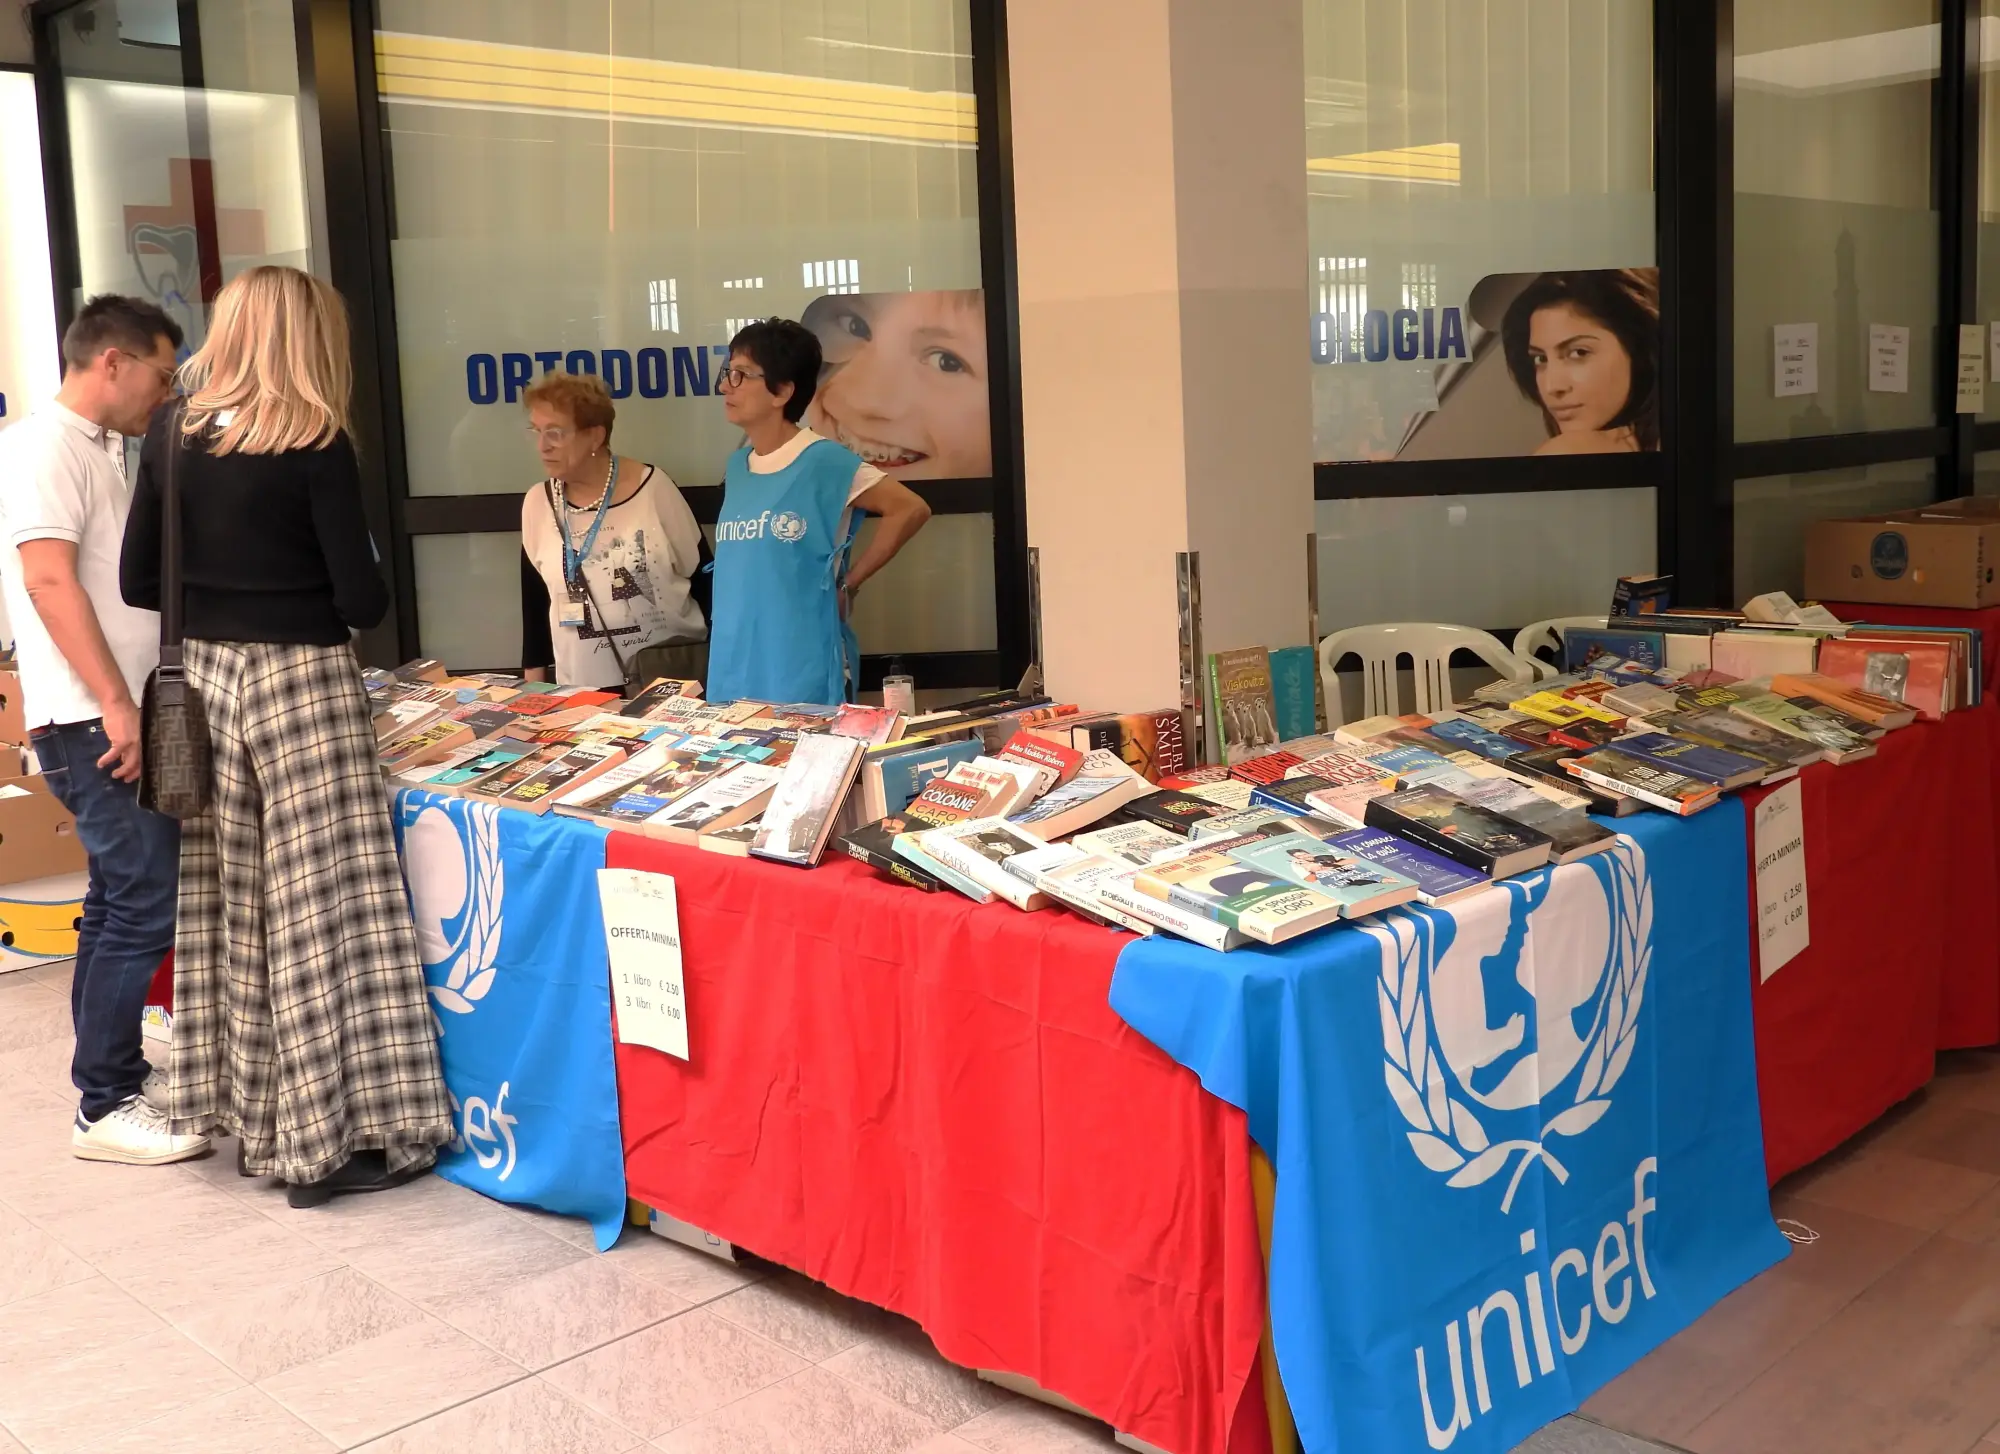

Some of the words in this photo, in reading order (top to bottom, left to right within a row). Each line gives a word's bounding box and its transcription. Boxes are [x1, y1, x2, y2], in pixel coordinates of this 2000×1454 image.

[715, 510, 770, 542] unicef
[621, 630, 652, 647] spirit
[655, 684, 681, 695] Tyler
[1224, 676, 1265, 691] Viskovitz
[1009, 743, 1024, 753] John
[1044, 755, 1065, 768] Roberts
[1296, 753, 1357, 776] GIORGIO
[921, 789, 978, 811] COLOANE
[932, 784, 977, 800] FRANCISCO
[915, 804, 958, 822] CAPO
[848, 843, 870, 857] TRUMAN
[848, 850, 869, 864] CAPOTE
[1777, 837, 1802, 860] MINIMA
[891, 861, 911, 877] Musica
[1101, 889, 1107, 897] di
[1108, 892, 1130, 906] meglio
[1783, 892, 1788, 903] €
[1790, 882, 1802, 899] 2.50
[1136, 904, 1165, 921] Cederna
[1250, 906, 1268, 914] LA
[1265, 892, 1311, 908] SPIAGGIA
[1272, 899, 1314, 916] D'ORO
[1164, 915, 1189, 931] Camilla
[1784, 914, 1789, 926] €
[1790, 905, 1803, 922] 6.00
[611, 927, 651, 941] OFFERTA
[651, 932, 678, 949] MINIMA
[623, 973, 629, 984] 1
[633, 973, 651, 987] libro
[659, 979, 664, 991] €
[665, 982, 679, 996] 2.50
[625, 996, 632, 1007] 3
[635, 997, 651, 1010] libri
[660, 1003, 665, 1015] €
[667, 1006, 681, 1020] 6.00
[449, 1081, 519, 1182] ef
[1415, 1156, 1657, 1451] unicef
